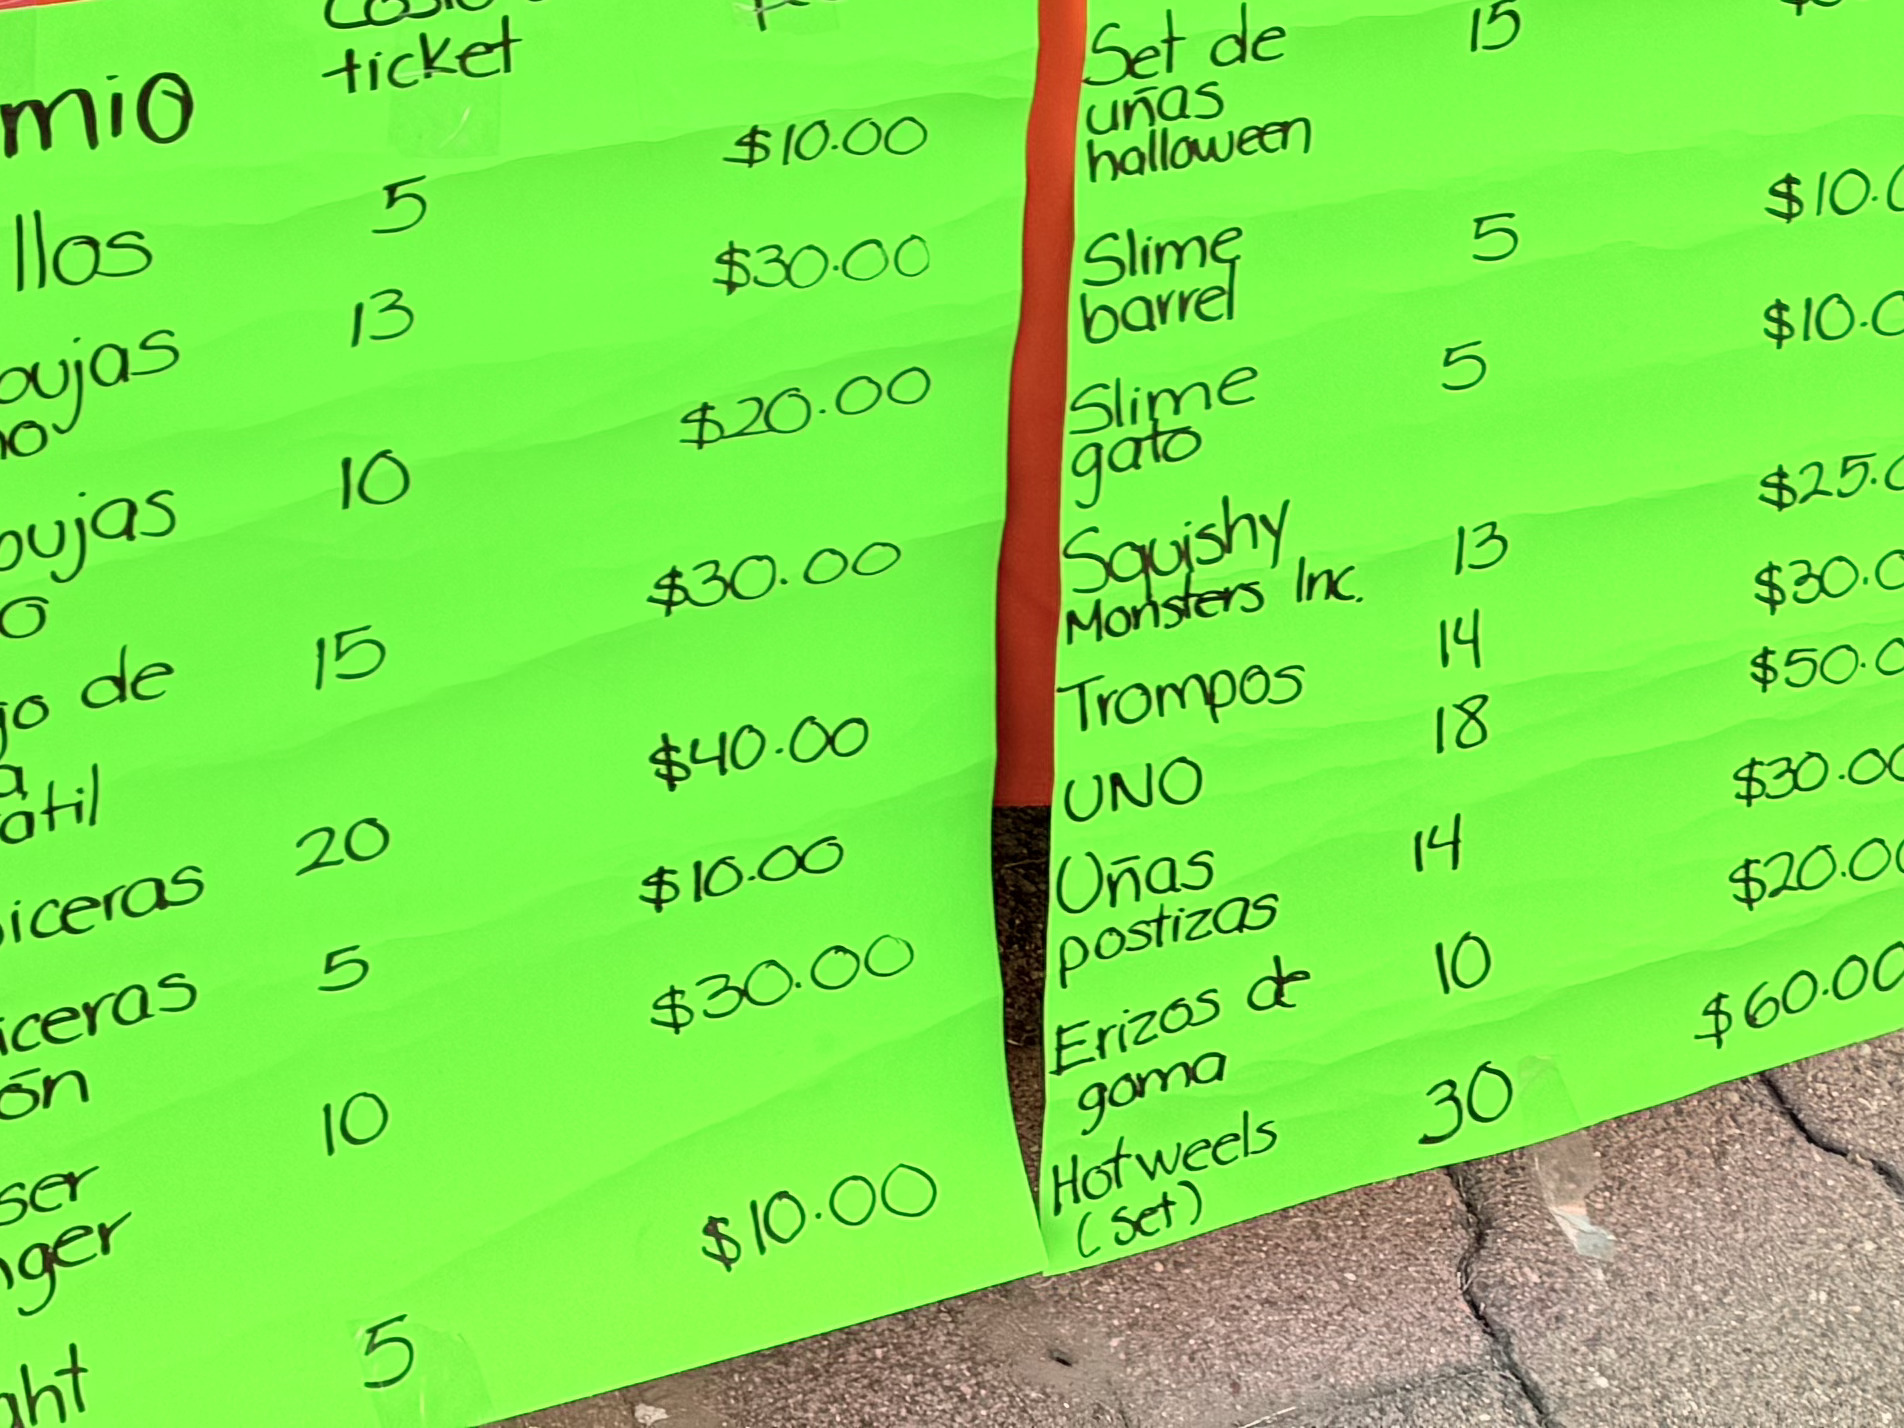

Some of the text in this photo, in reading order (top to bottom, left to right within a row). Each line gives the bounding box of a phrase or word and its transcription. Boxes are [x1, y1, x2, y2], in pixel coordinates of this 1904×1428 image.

[323, 15, 521, 93] ticket
[1080, 3, 1286, 90] Set de
[723, 117, 927, 168] $10.00
[1086, 81, 1224, 135] uñas
[1086, 112, 1311, 182] halloween
[1080, 252, 1240, 344] barrel
[1083, 227, 1242, 291] Slime
[680, 367, 931, 450] $20.00
[1070, 367, 1257, 438] Slime
[1072, 418, 1202, 509] gato
[1062, 496, 1289, 601] Squishy
[1066, 566, 1264, 644] Monsters
[81, 647, 174, 708] de
[1057, 662, 1306, 730] Trompos
[1064, 756, 1202, 822] UNO
[1056, 887, 1278, 989] postizas
[1050, 989, 1226, 1081] Erizos
[1078, 1052, 1226, 1135] goma
